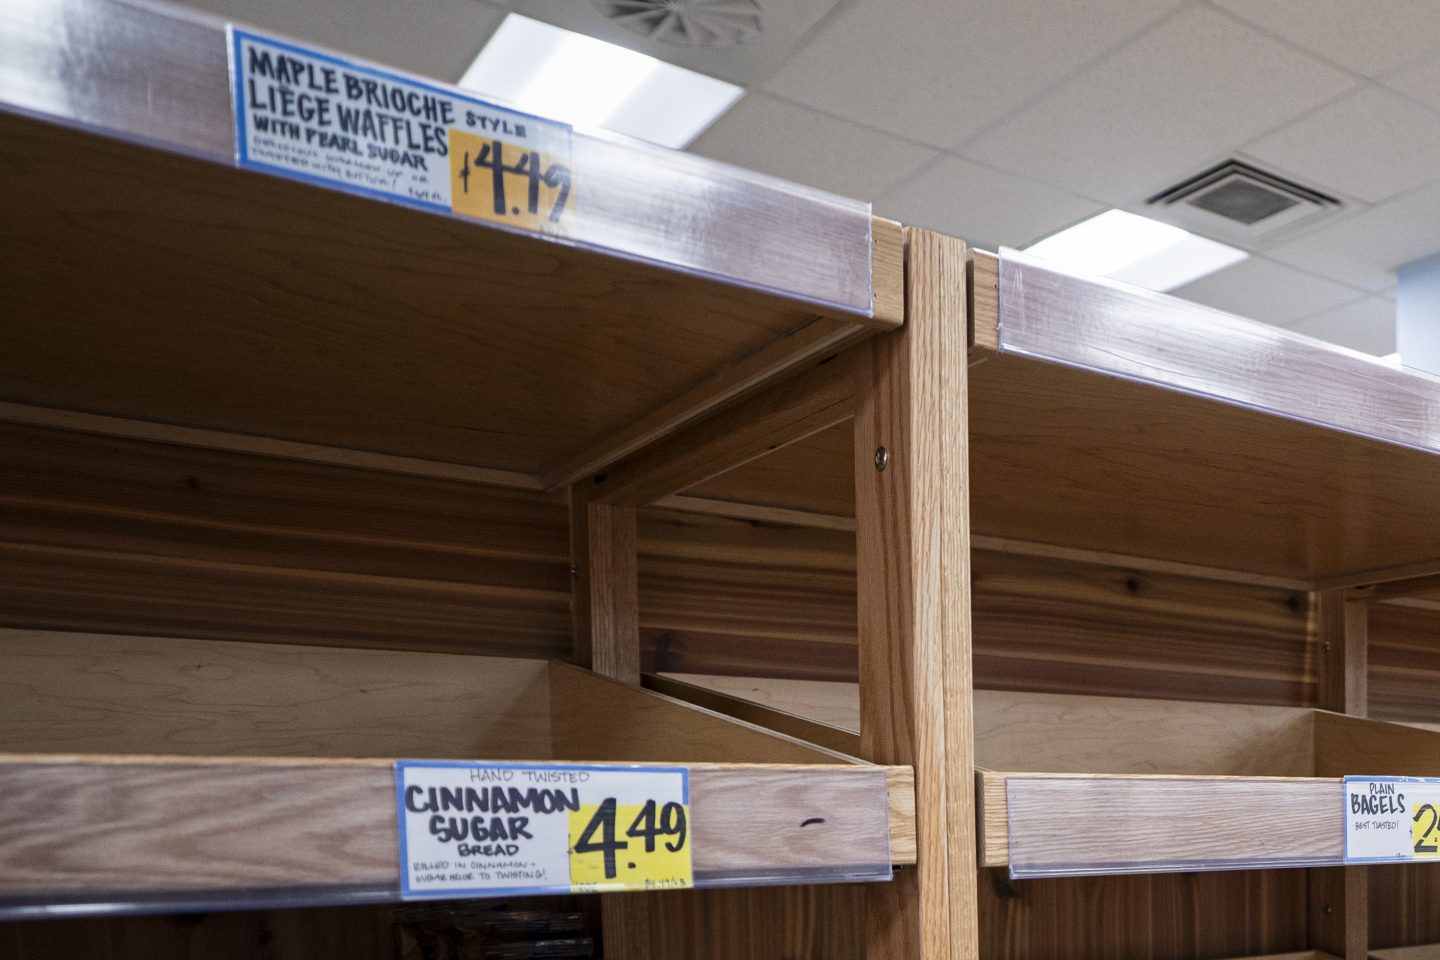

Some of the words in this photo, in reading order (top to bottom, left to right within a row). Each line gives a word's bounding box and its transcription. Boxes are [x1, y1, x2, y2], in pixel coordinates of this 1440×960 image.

[248, 47, 338, 94] MAPLE
[342, 73, 455, 125] BRIOCHE
[465, 111, 527, 138] STYLE
[337, 104, 449, 157] WAFFLES
[253, 114, 300, 139] WITH
[305, 127, 364, 157] PEARL
[367, 143, 428, 172] SUGAR
[469, 769, 514, 783] HAND
[522, 770, 590, 784] TWISTED
[405, 785, 581, 814] CINNAMON
[1369, 782, 1395, 795] PLAIN
[1350, 792, 1406, 815] BAGELS
[429, 815, 533, 843] SUGAR
[457, 843, 519, 858] BREAD
[455, 861, 466, 869] IN
[471, 860, 527, 871] CINNAMON
[478, 872, 490, 881] TO
[495, 869, 547, 881] TWISTING!
